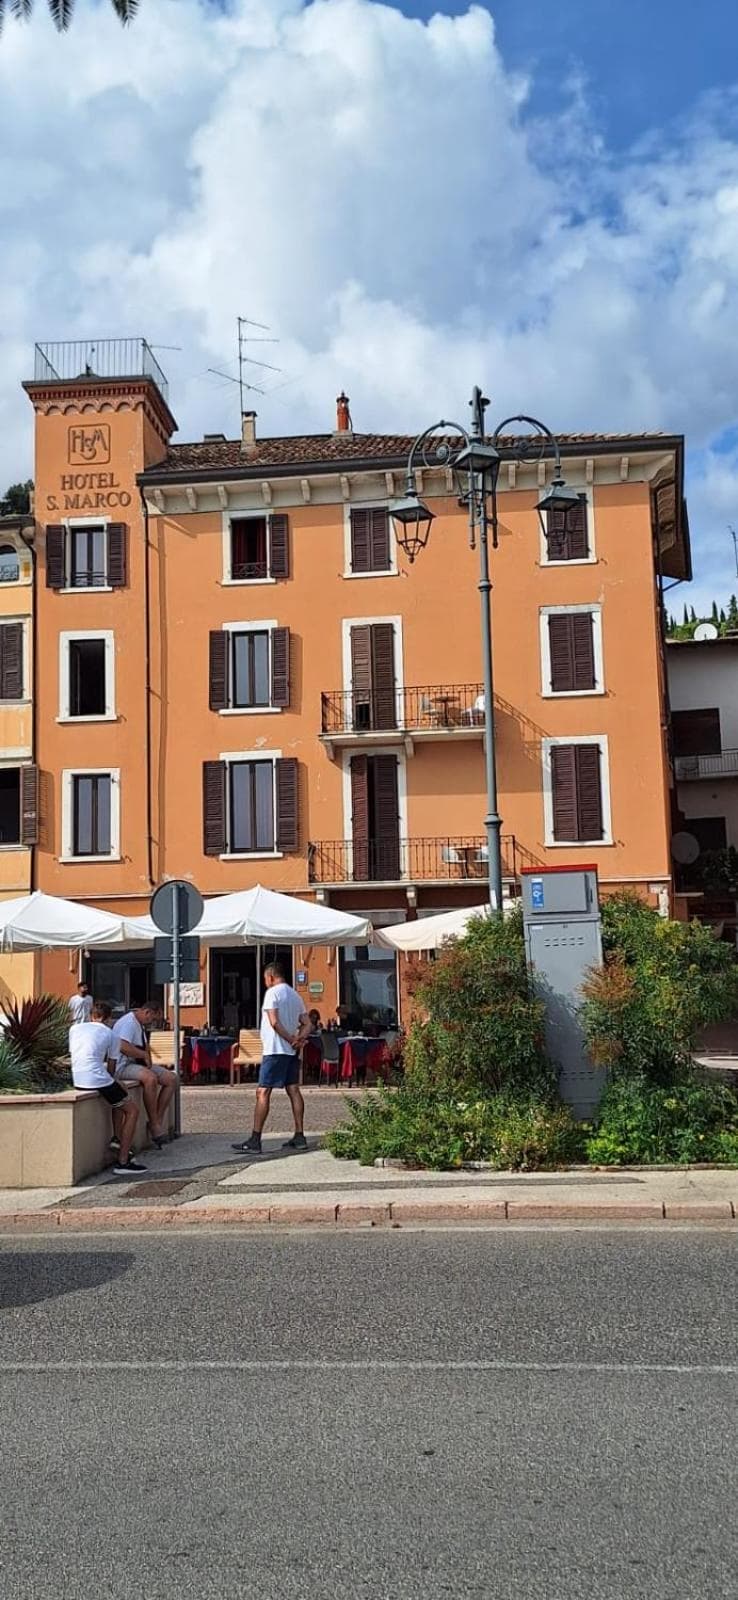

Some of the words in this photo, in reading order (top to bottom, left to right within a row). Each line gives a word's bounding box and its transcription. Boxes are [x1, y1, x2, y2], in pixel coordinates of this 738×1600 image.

[60, 472, 120, 491] HOTEL
[46, 495, 59, 511] S.
[64, 491, 132, 510] MARCO
